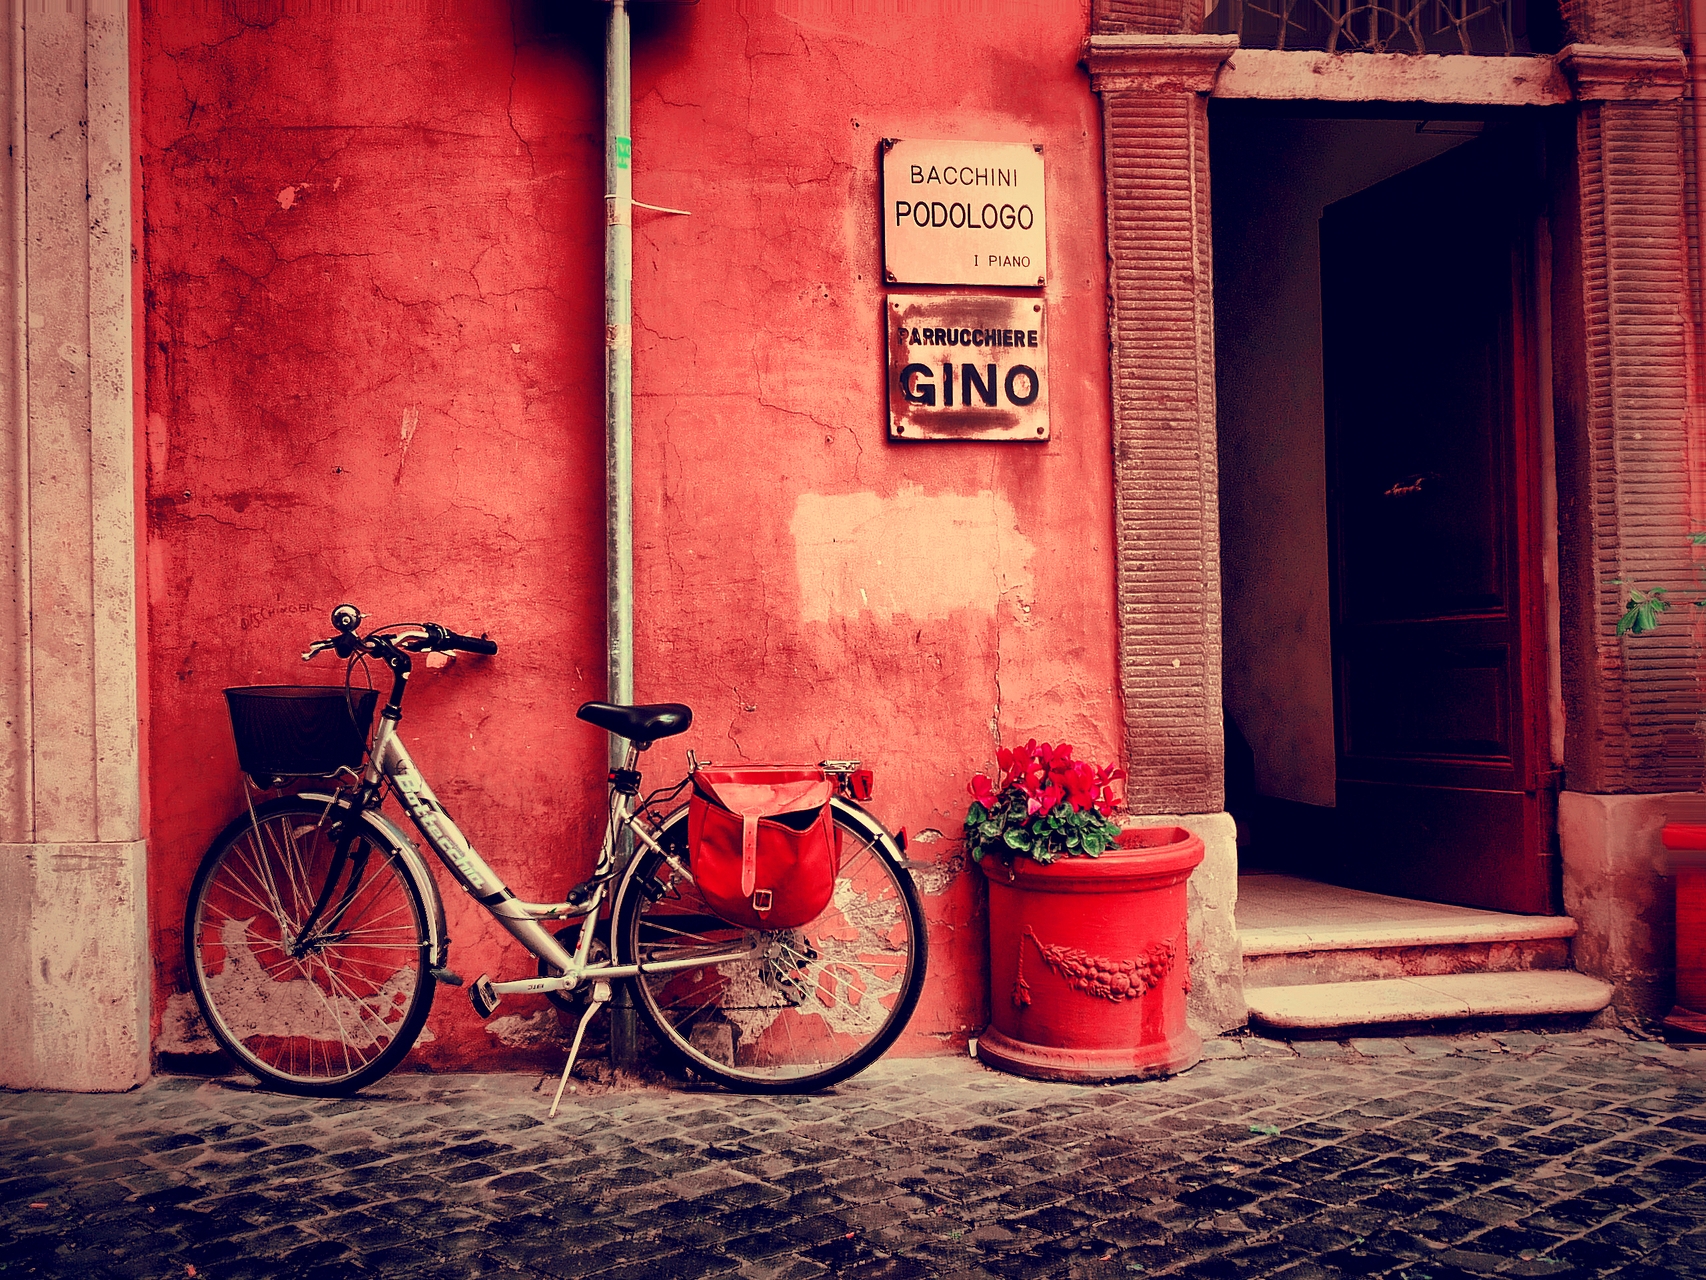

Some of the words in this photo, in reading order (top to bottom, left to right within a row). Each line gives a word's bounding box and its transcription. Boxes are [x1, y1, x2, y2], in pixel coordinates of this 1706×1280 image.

[910, 165, 1017, 187] BACCHINI
[896, 201, 1034, 230] PODOLOGO
[974, 254, 979, 267] I
[988, 255, 1031, 268] PIANO
[898, 327, 1039, 348] PARRUCCHIERE
[900, 363, 1040, 407] GINO
[393, 774, 484, 890] Bottecchia
